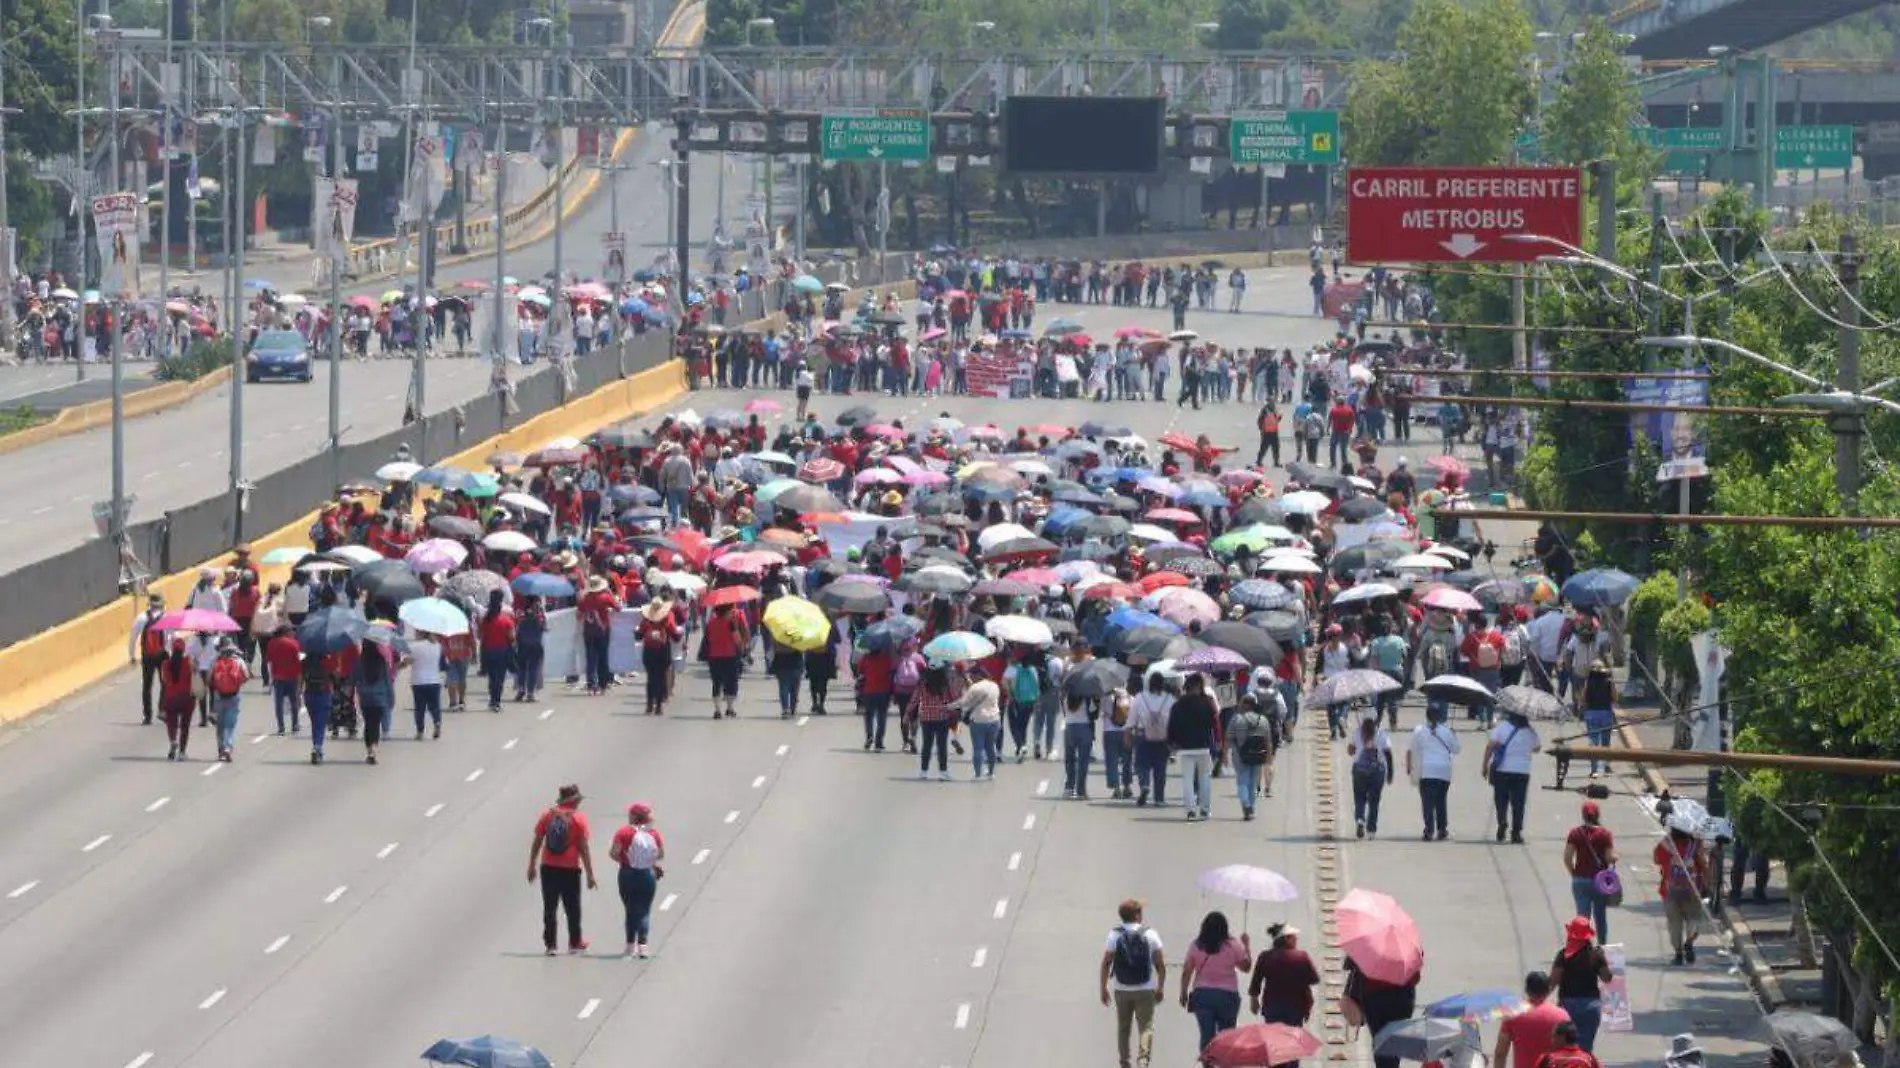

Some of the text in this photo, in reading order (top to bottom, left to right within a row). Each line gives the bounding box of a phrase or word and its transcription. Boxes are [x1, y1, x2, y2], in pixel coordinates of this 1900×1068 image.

[1244, 123, 1295, 135] TERMINAL
[1241, 148, 1291, 160] TERMINAL
[1352, 178, 1577, 197] CARRIL PREFERENTE
[1402, 208, 1524, 229] METROBUS
